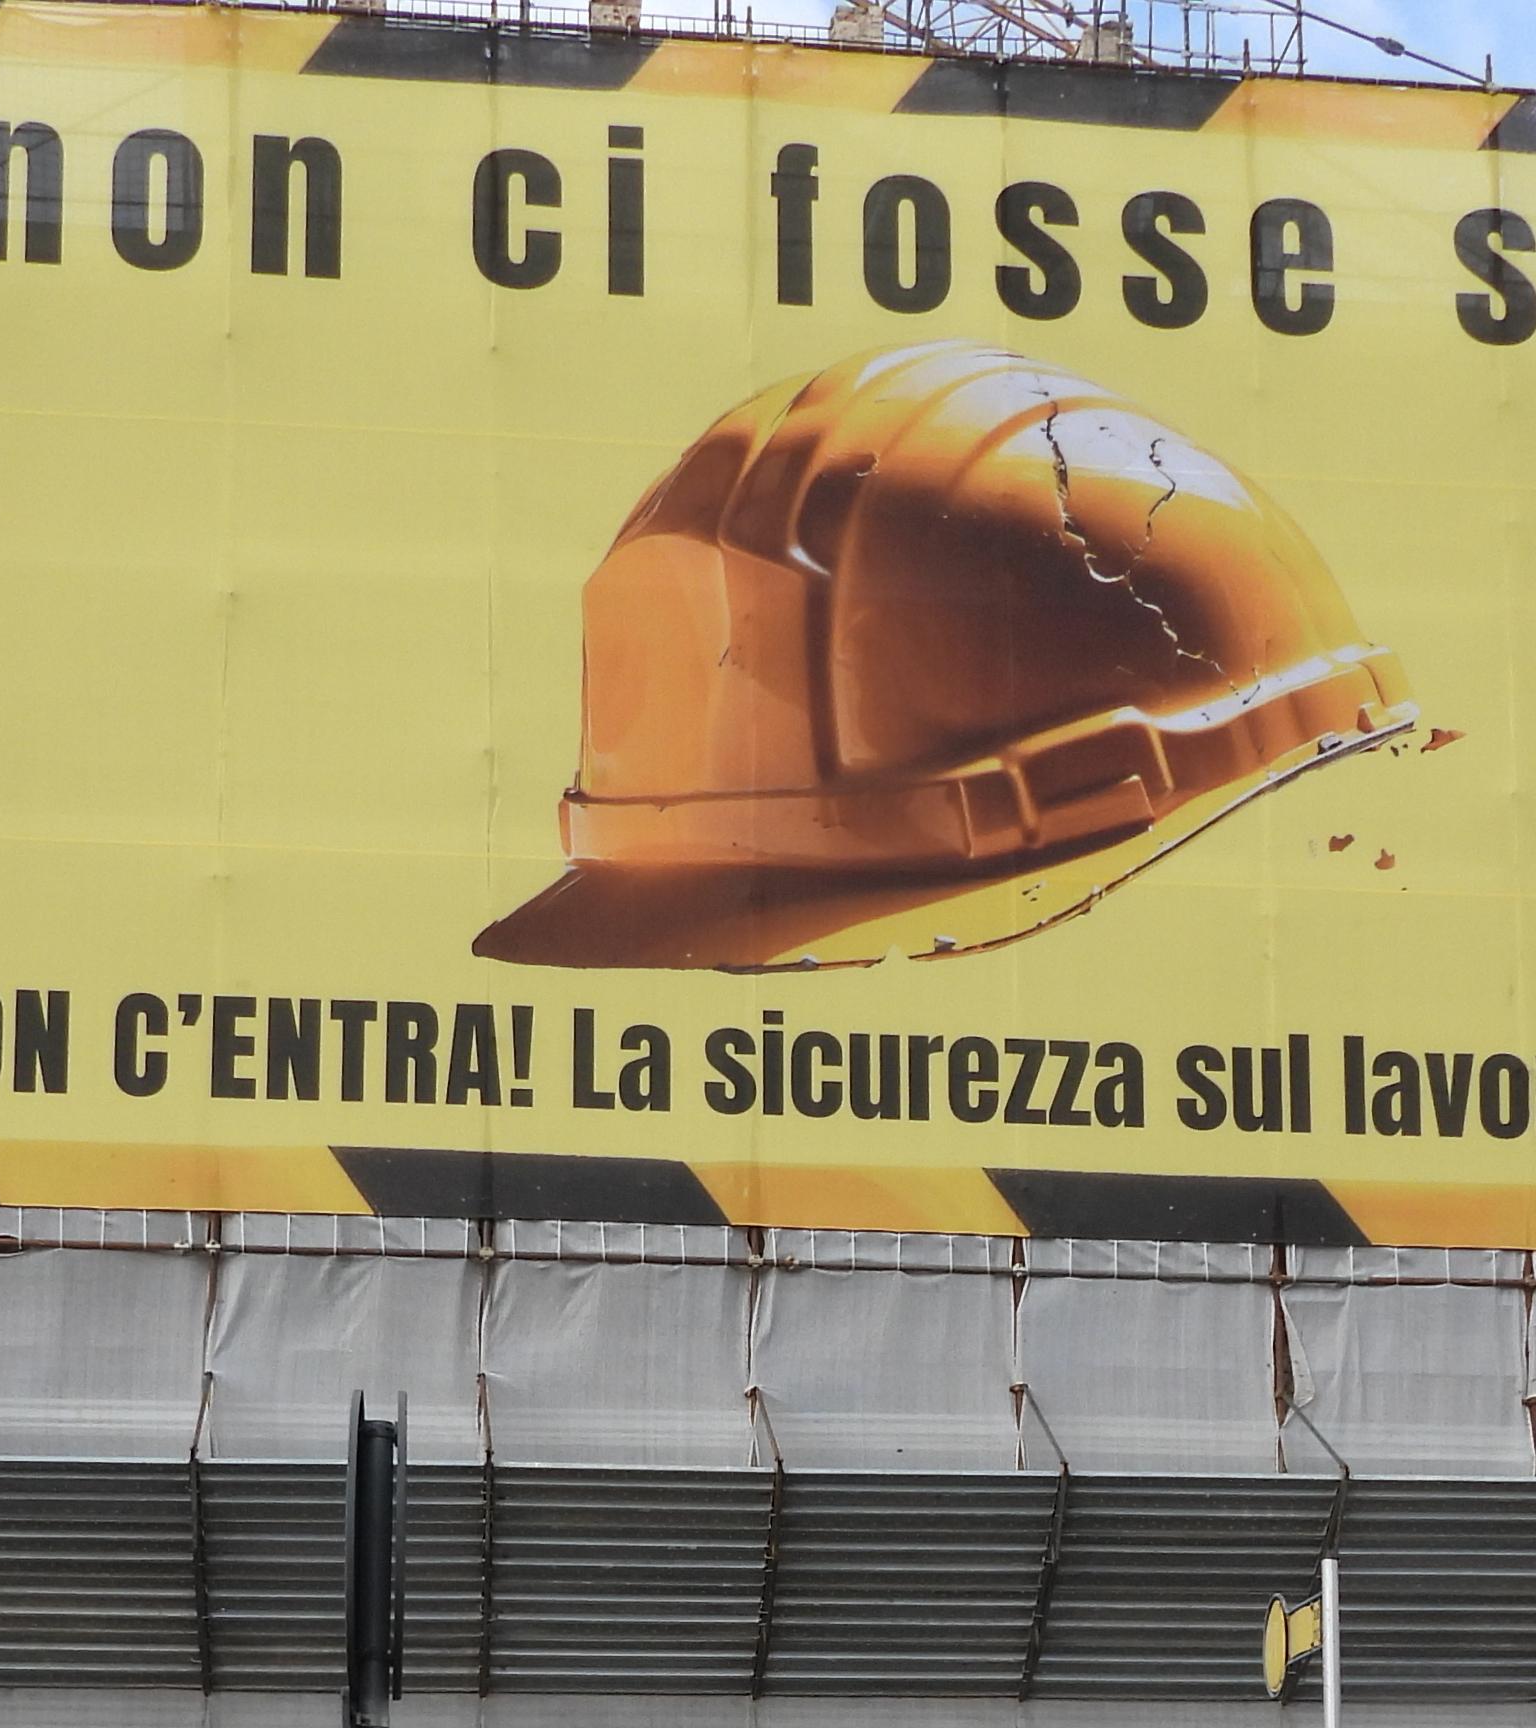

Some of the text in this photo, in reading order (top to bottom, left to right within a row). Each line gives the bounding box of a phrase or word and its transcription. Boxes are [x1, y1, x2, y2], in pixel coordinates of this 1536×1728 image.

[472, 125, 645, 297] ci
[771, 142, 1336, 337] fosse
[112, 992, 535, 1108] C'ENTRA!
[572, 1008, 672, 1112] La
[704, 1010, 1145, 1129] sicurezza
[1175, 1034, 1312, 1134] sul
